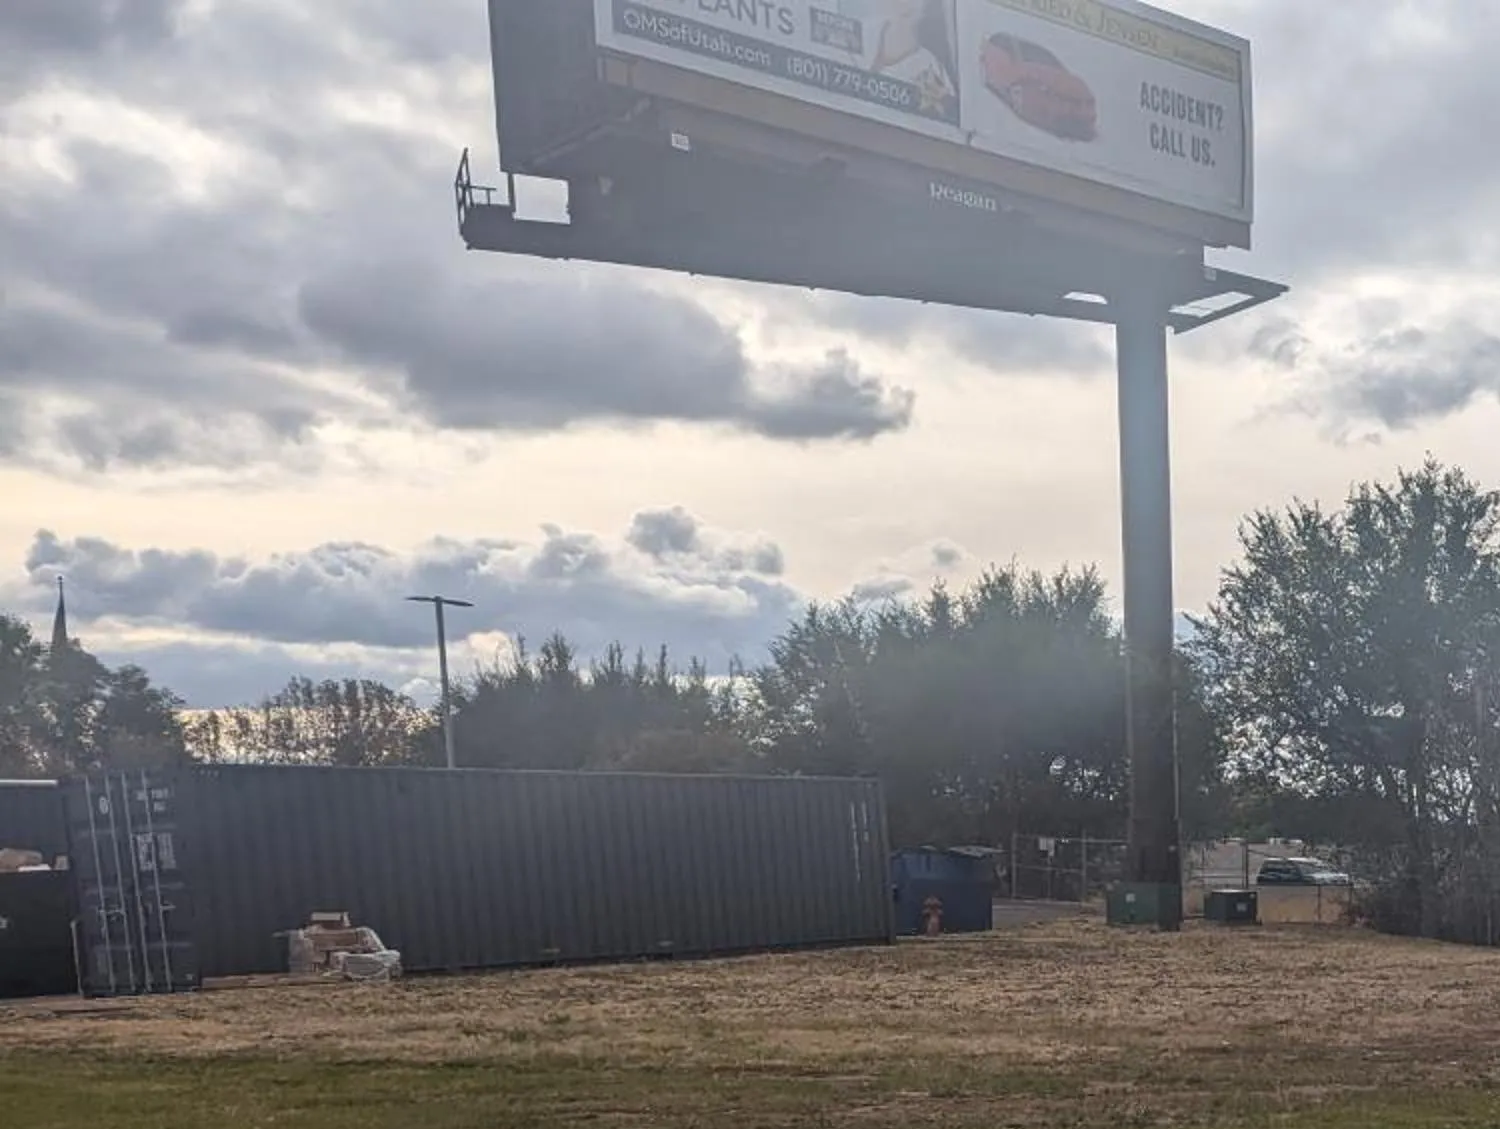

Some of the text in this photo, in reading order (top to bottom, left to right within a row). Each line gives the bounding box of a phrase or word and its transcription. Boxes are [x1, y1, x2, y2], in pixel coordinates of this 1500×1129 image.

[680, 0, 796, 35] LANTS
[623, 8, 771, 66] OMSofUtah.com
[786, 57, 829, 87] (801)
[833, 67, 910, 106] 779-0506
[1140, 81, 1224, 131] ACCIDENT?
[1150, 122, 1216, 168] CALL US.
